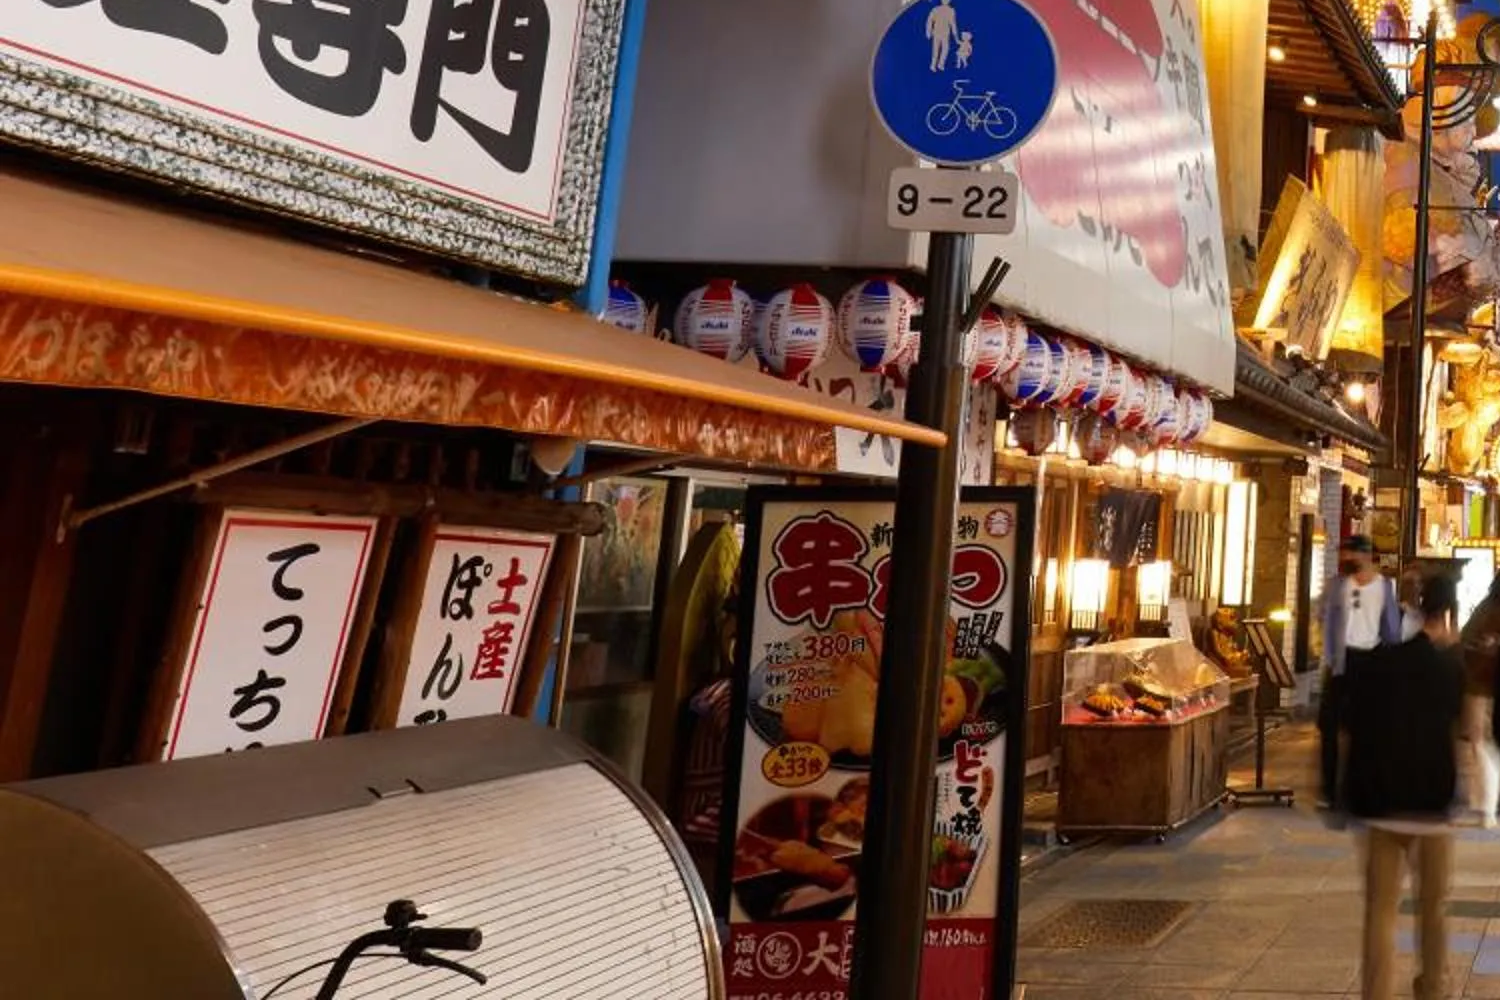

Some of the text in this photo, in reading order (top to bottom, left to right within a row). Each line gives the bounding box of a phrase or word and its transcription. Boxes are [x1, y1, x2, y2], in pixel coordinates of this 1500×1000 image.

[897, 183, 1009, 219] 9-22
[225, 542, 320, 755] てっち
[413, 553, 493, 726] ぽん
[470, 558, 528, 680] 土産
[803, 633, 865, 661] 380円
